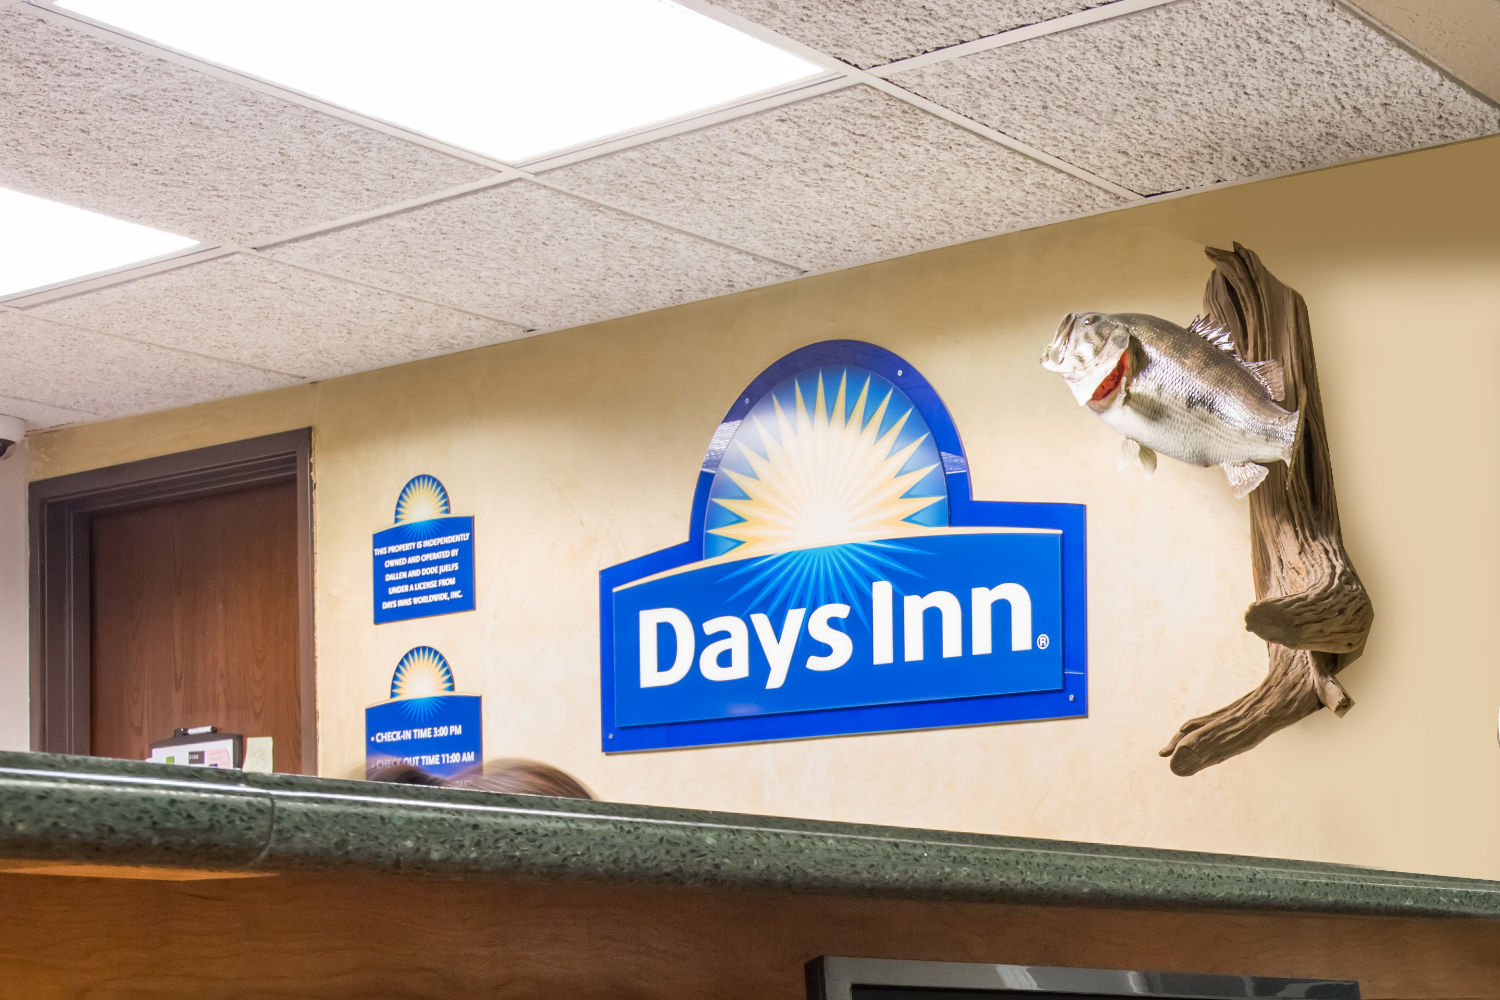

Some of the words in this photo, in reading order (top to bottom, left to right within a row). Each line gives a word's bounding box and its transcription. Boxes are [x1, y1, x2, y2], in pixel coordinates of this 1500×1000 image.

[374, 547, 387, 556] THIS
[388, 542, 416, 554] PROPERTY
[416, 541, 423, 549] IS
[423, 533, 470, 548] INDEPENDENTLY
[384, 557, 407, 568] OWNED
[407, 555, 420, 564] AND
[420, 550, 450, 562] OPERATED
[451, 548, 459, 557] BY
[407, 569, 421, 578] AND
[388, 584, 409, 595] UNDER
[409, 584, 415, 592] A
[414, 580, 438, 591] LICENSE
[438, 577, 456, 587] FROM
[382, 600, 397, 610] DAYS
[397, 597, 412, 607] INNS
[412, 592, 450, 605] WORLDWIDE,
[450, 590, 463, 599] INC.
[638, 602, 854, 690] Days
[872, 580, 1032, 665] Inn
[375, 729, 412, 743] CHECK-IN
[413, 727, 432, 740] TIME
[433, 726, 448, 738] 3:00
[449, 724, 462, 736] PM
[402, 755, 420, 767] OUT
[420, 754, 440, 766] TIME
[441, 752, 461, 765] 11:00
[461, 751, 475, 763] AM
